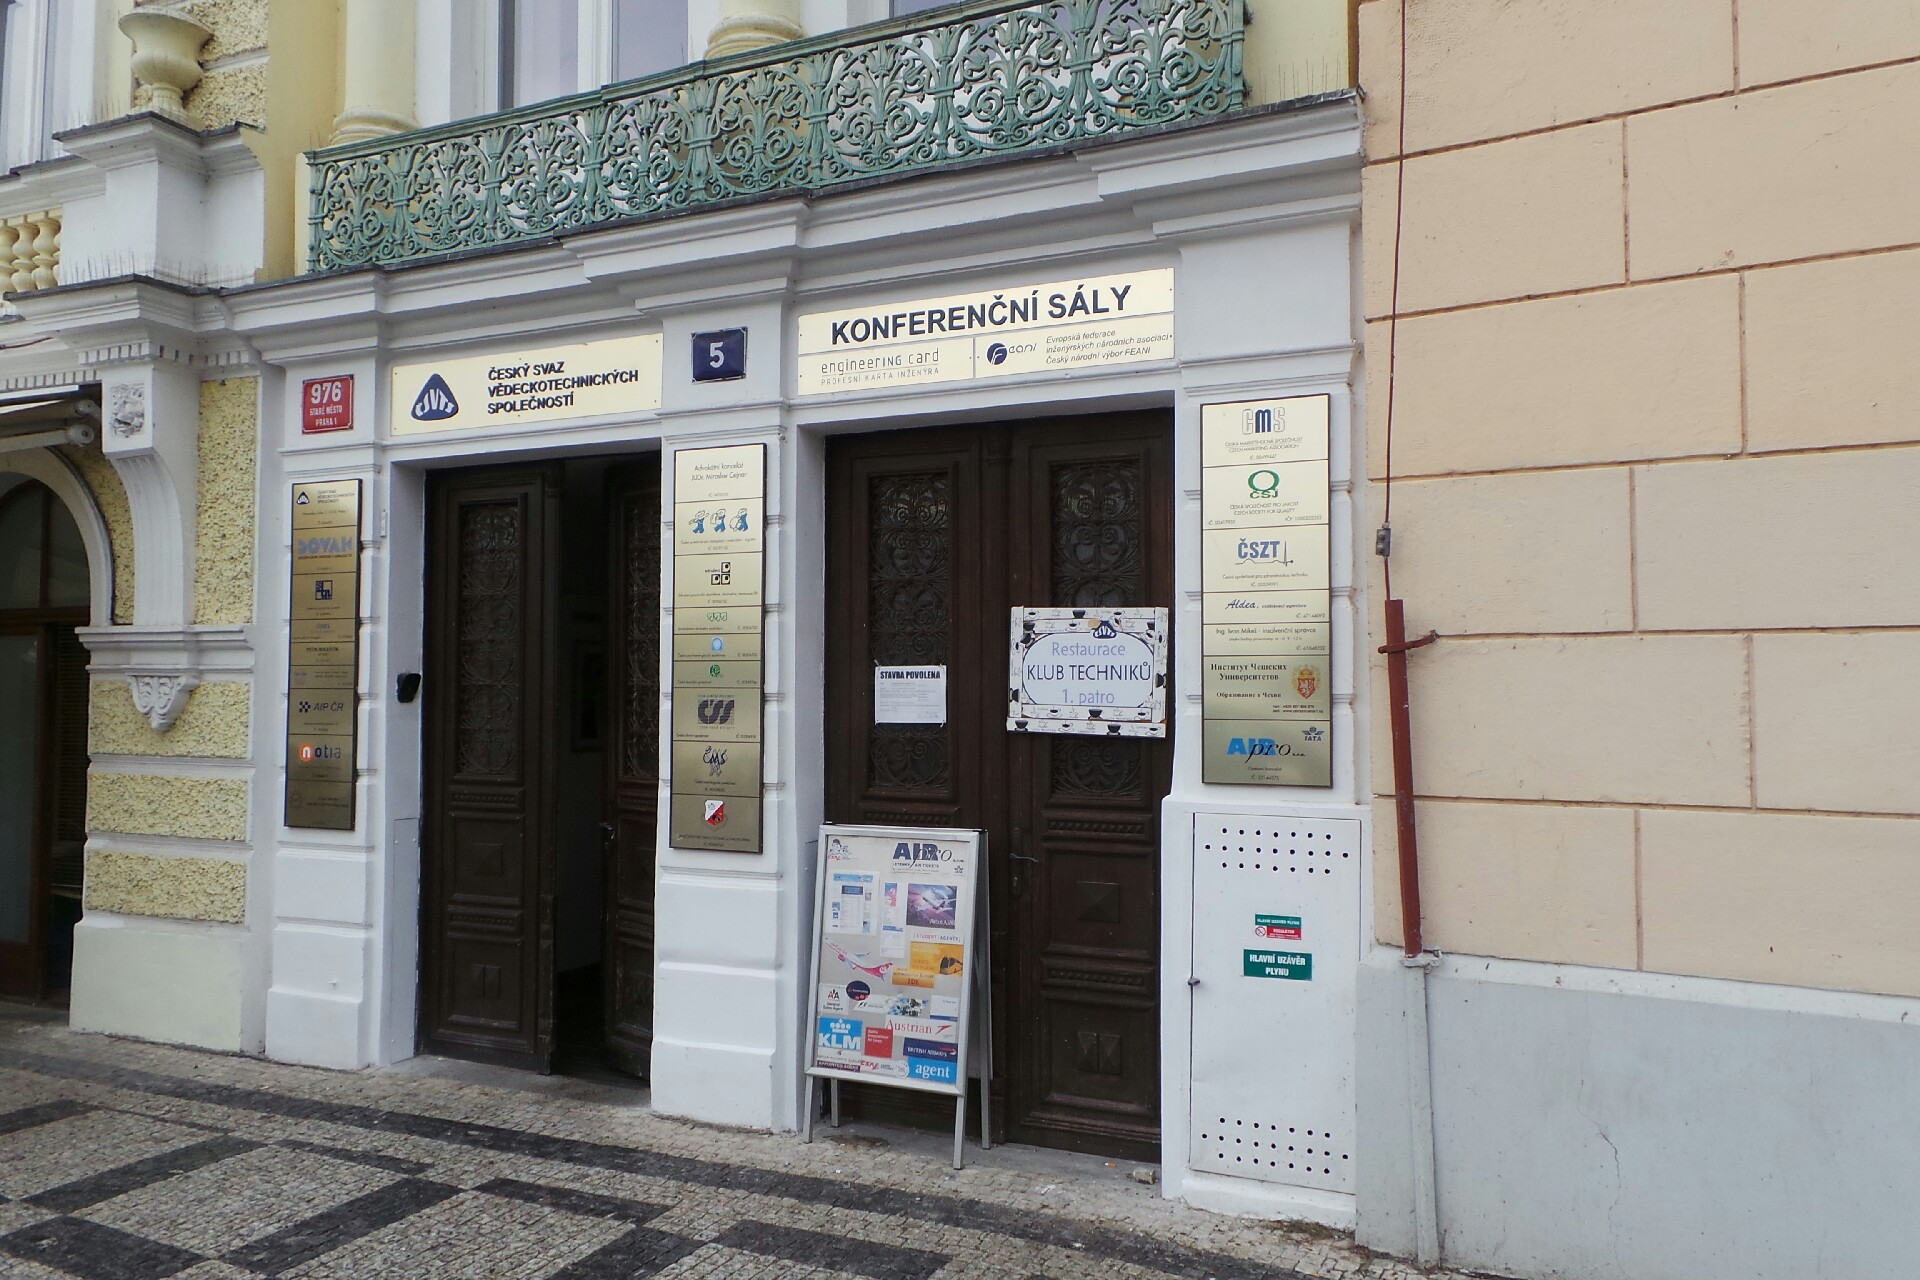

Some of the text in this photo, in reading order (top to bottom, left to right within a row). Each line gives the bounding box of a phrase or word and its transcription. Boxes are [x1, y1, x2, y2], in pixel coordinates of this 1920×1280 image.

[832, 283, 1132, 345] KONFERENČNÍ SÁLY
[1046, 332, 1081, 344] Evropská
[708, 342, 725, 368] 5
[908, 347, 939, 364] card
[1046, 354, 1068, 365] Český
[1102, 349, 1123, 360] výbor
[1124, 346, 1151, 356] FEANI
[488, 361, 564, 381] ČESKÝ SVAZ
[865, 372, 894, 382] KARTA
[898, 367, 939, 378] INŽENÝRA
[488, 369, 638, 398] VĚDECKOTECHNICKÝCH
[310, 381, 342, 404] 976
[488, 391, 574, 414] SPOLEČNOSTÍ
[316, 418, 333, 426] PRAHA
[1238, 538, 1280, 559] ČSZT
[1052, 642, 1126, 656] Restaurace
[880, 670, 941, 679] STAVBA POVOLENA
[1027, 662, 1151, 680] KLUB TECHNIKŮ
[1210, 663, 1248, 672] Институт
[1219, 673, 1279, 682] Университетов
[1062, 688, 1114, 705] 1. patro
[314, 702, 329, 711] AIP
[1249, 954, 1306, 966] HLAVNÍ UZÁVĚR
[1265, 967, 1290, 976] PLYNU
[886, 1019, 932, 1034] Austrian
[818, 1032, 860, 1050] KLM
[916, 1064, 950, 1079] agent
